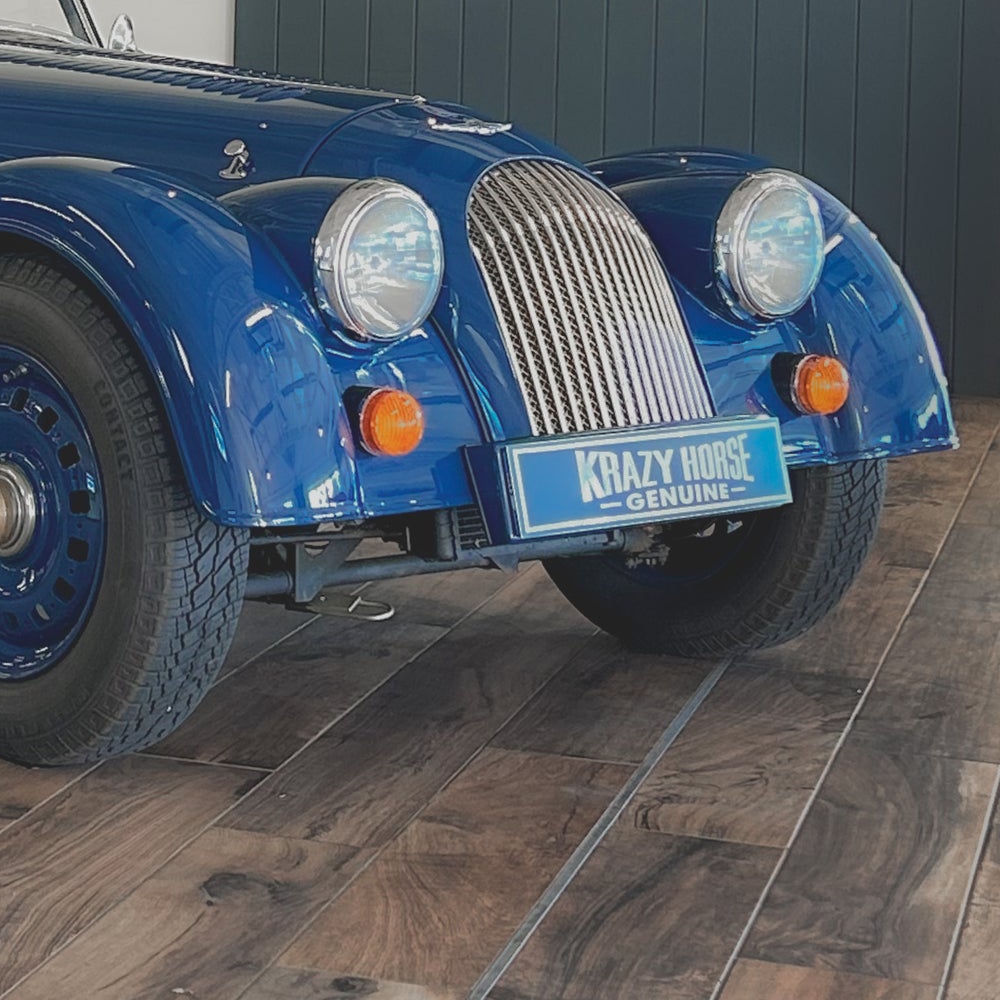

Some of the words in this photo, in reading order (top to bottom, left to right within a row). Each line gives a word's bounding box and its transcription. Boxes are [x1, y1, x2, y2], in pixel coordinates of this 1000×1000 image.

[93, 379, 134, 481] CONTACT
[574, 448, 674, 503] KRAZY
[680, 432, 755, 482] HORSE
[625, 482, 730, 511] GENUINE
